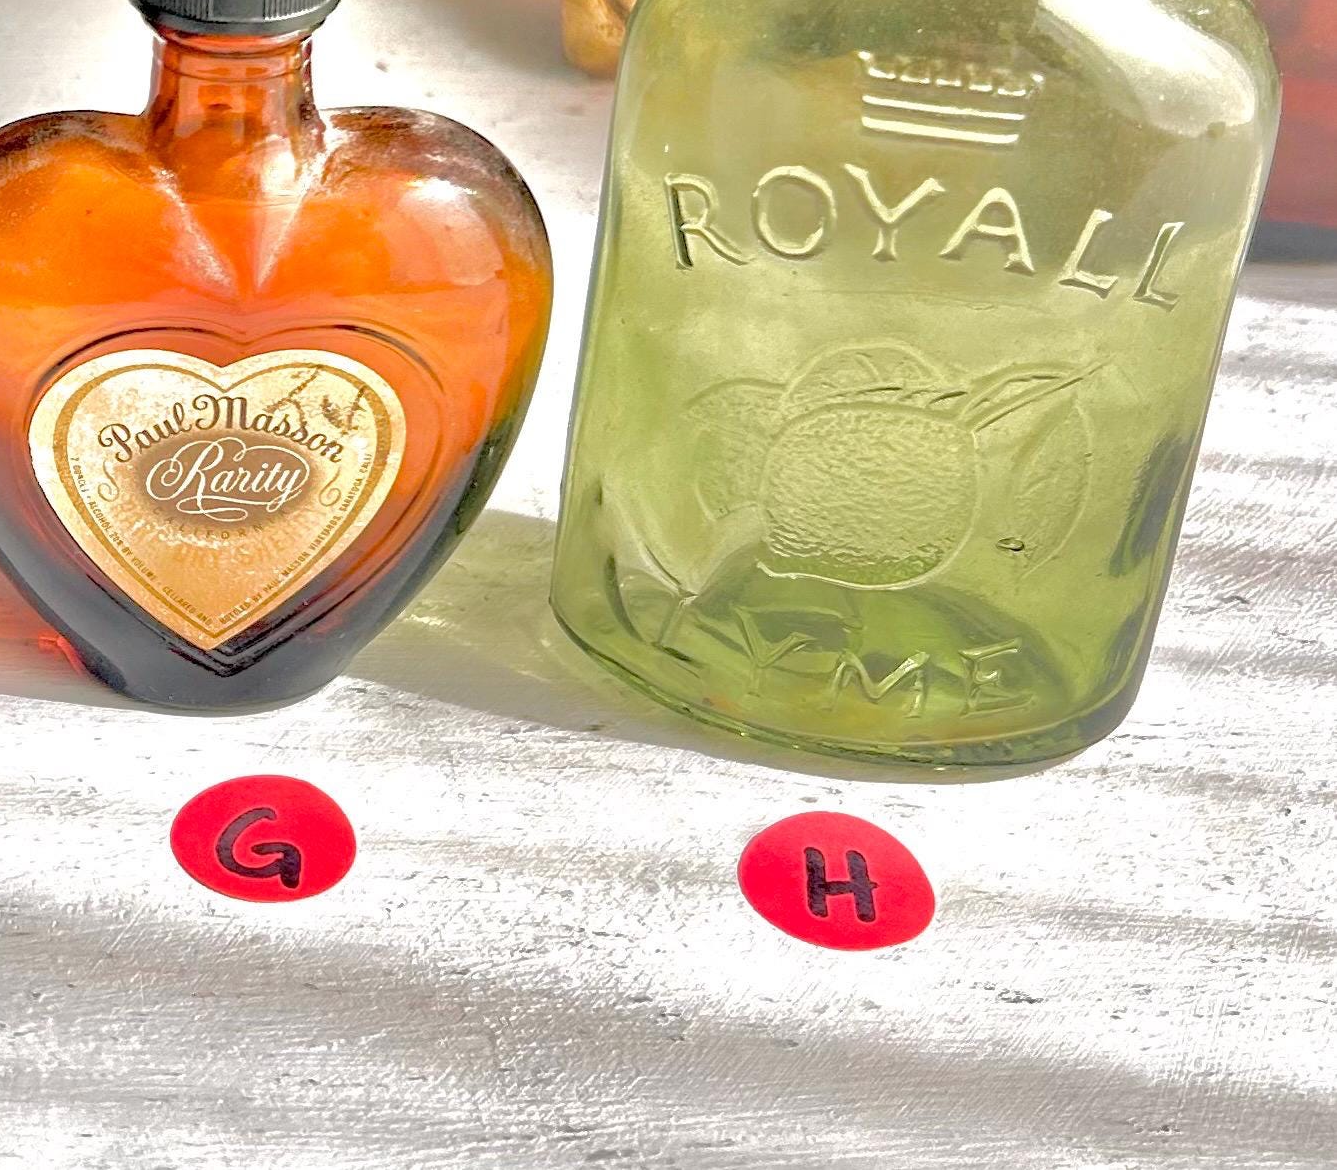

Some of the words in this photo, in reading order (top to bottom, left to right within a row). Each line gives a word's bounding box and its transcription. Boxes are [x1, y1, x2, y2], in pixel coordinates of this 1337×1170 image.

[663, 164, 1186, 313] ROYALL
[98, 402, 193, 464] Paul
[192, 393, 345, 464] Masson
[145, 437, 310, 522] Rarity
[215, 806, 303, 890] G
[803, 845, 880, 923] H
